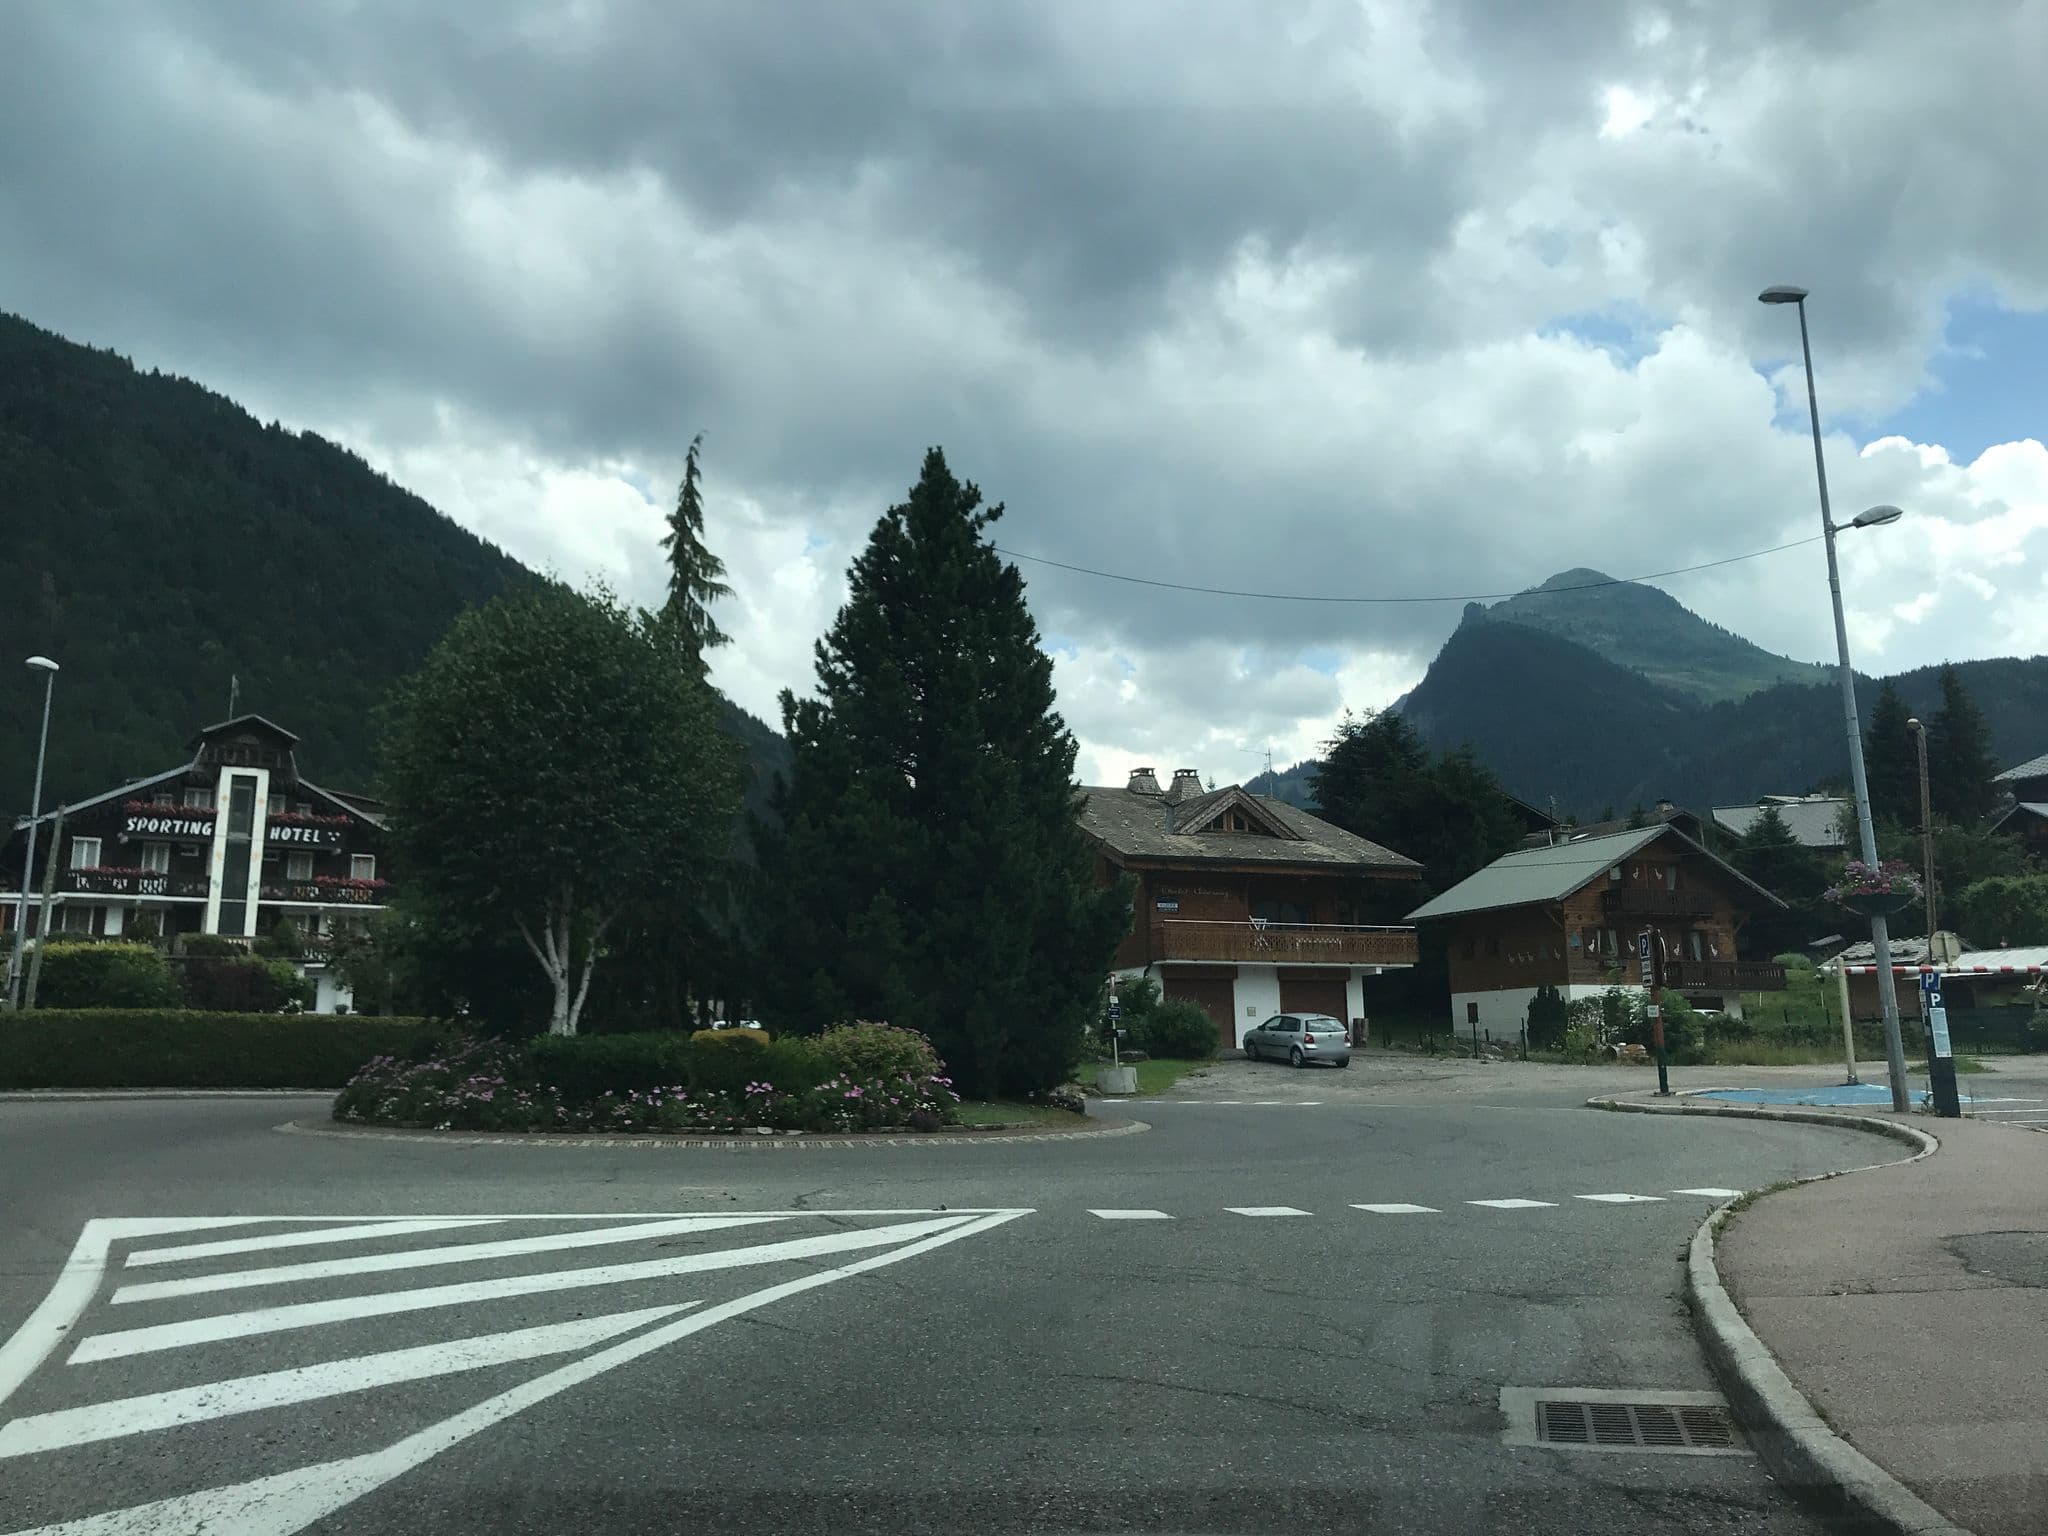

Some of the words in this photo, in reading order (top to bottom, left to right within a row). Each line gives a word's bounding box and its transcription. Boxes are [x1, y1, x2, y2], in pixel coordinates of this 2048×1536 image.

[127, 817, 213, 836] SPORTING
[270, 826, 320, 843] HOTEL
[1926, 973, 1934, 987] P
[1931, 993, 1941, 1007] P
